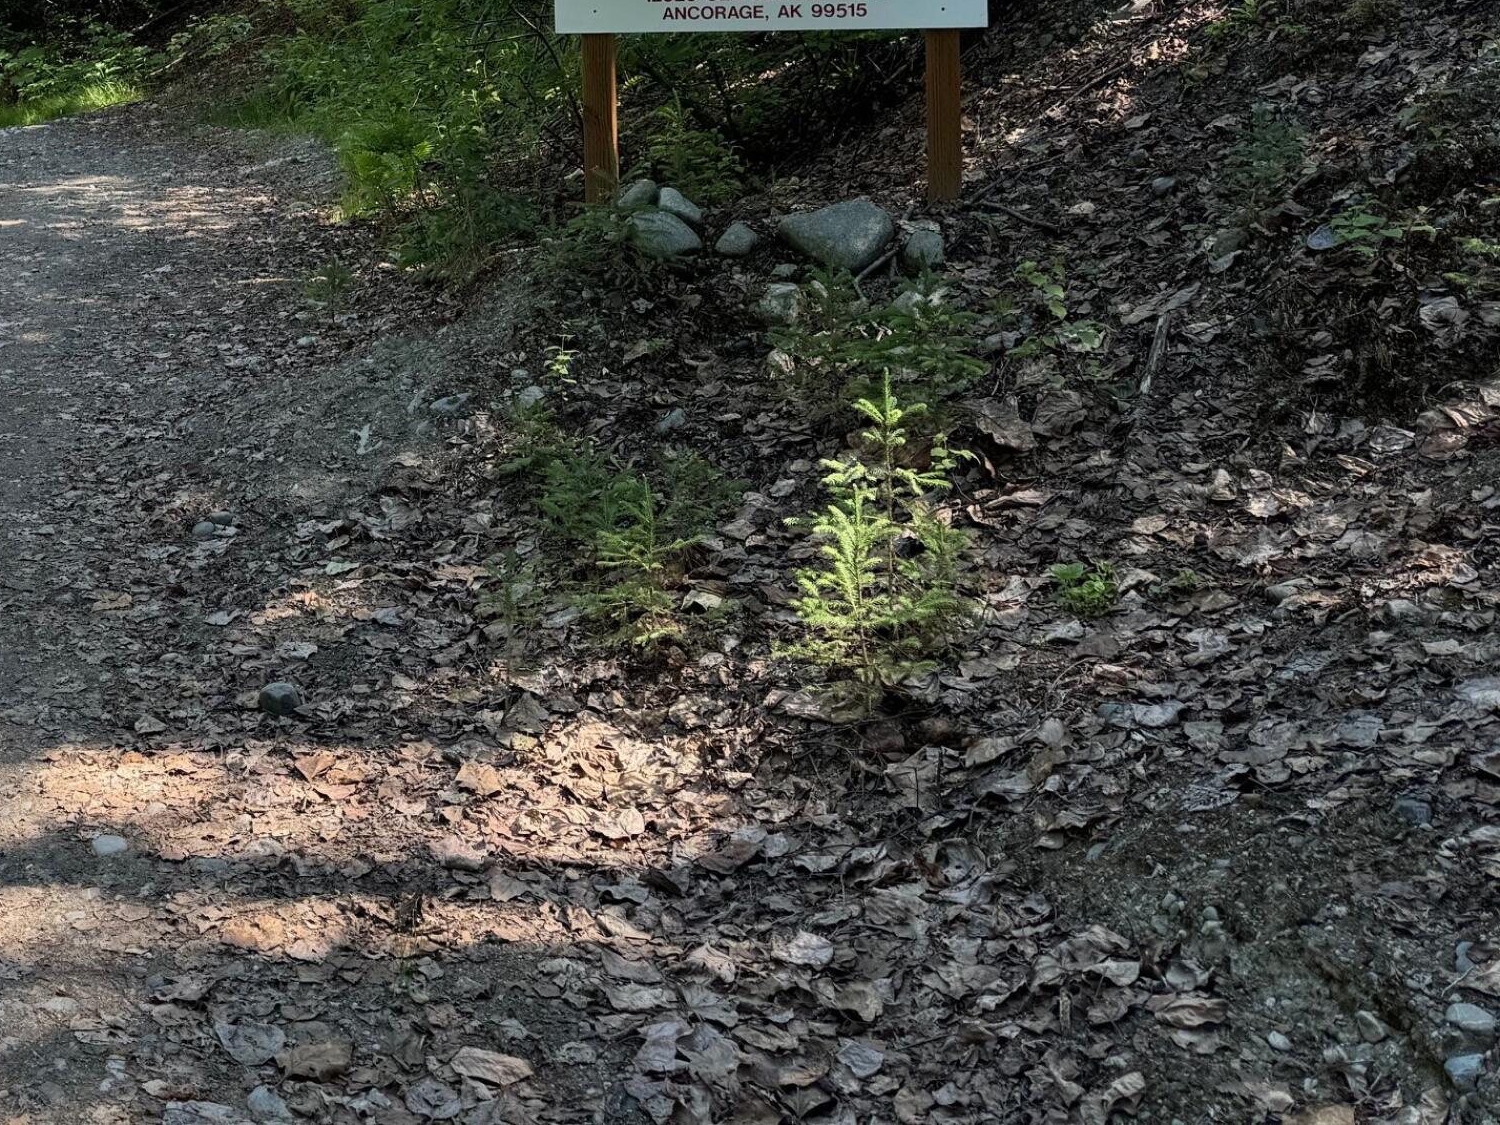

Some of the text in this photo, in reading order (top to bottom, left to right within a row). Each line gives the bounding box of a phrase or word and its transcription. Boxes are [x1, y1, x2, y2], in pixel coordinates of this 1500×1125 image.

[663, 3, 867, 21] ANCORAGE, AK 99515
